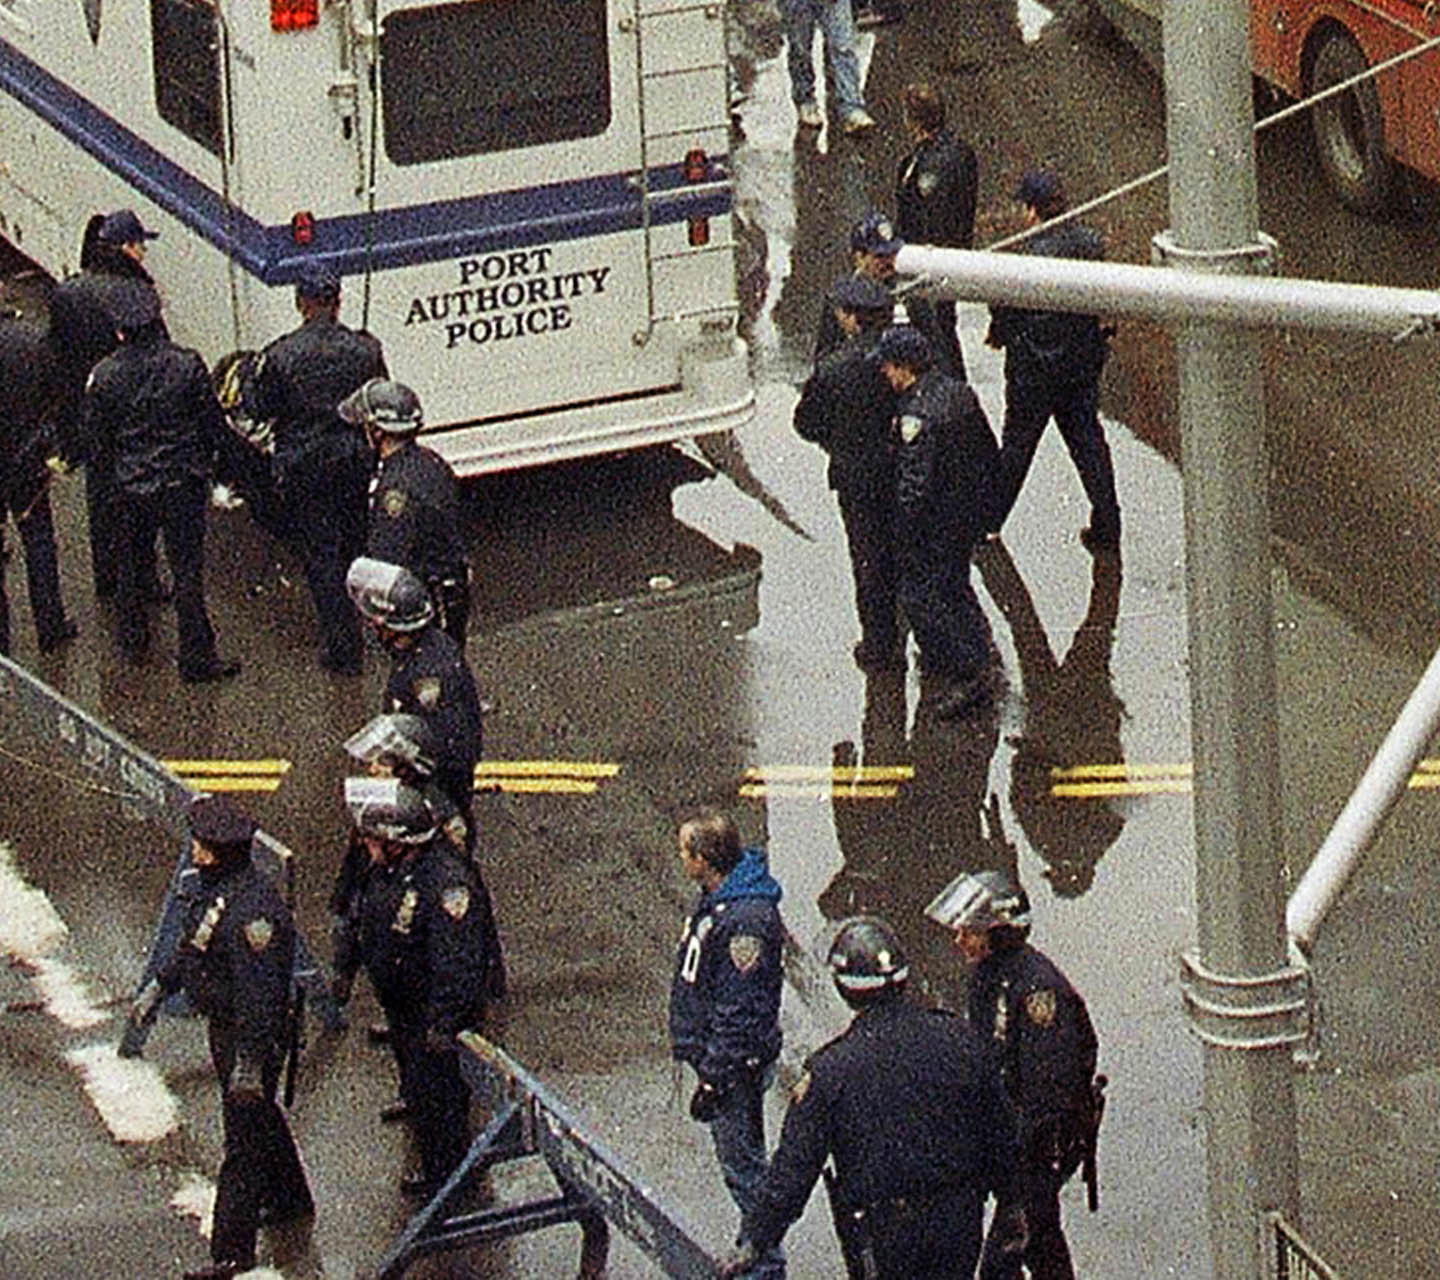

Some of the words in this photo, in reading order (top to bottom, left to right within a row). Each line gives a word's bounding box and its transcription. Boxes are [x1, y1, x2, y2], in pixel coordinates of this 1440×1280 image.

[460, 247, 552, 286] PORT
[404, 266, 611, 327] AUTHORITY
[445, 303, 573, 350] POLICE
